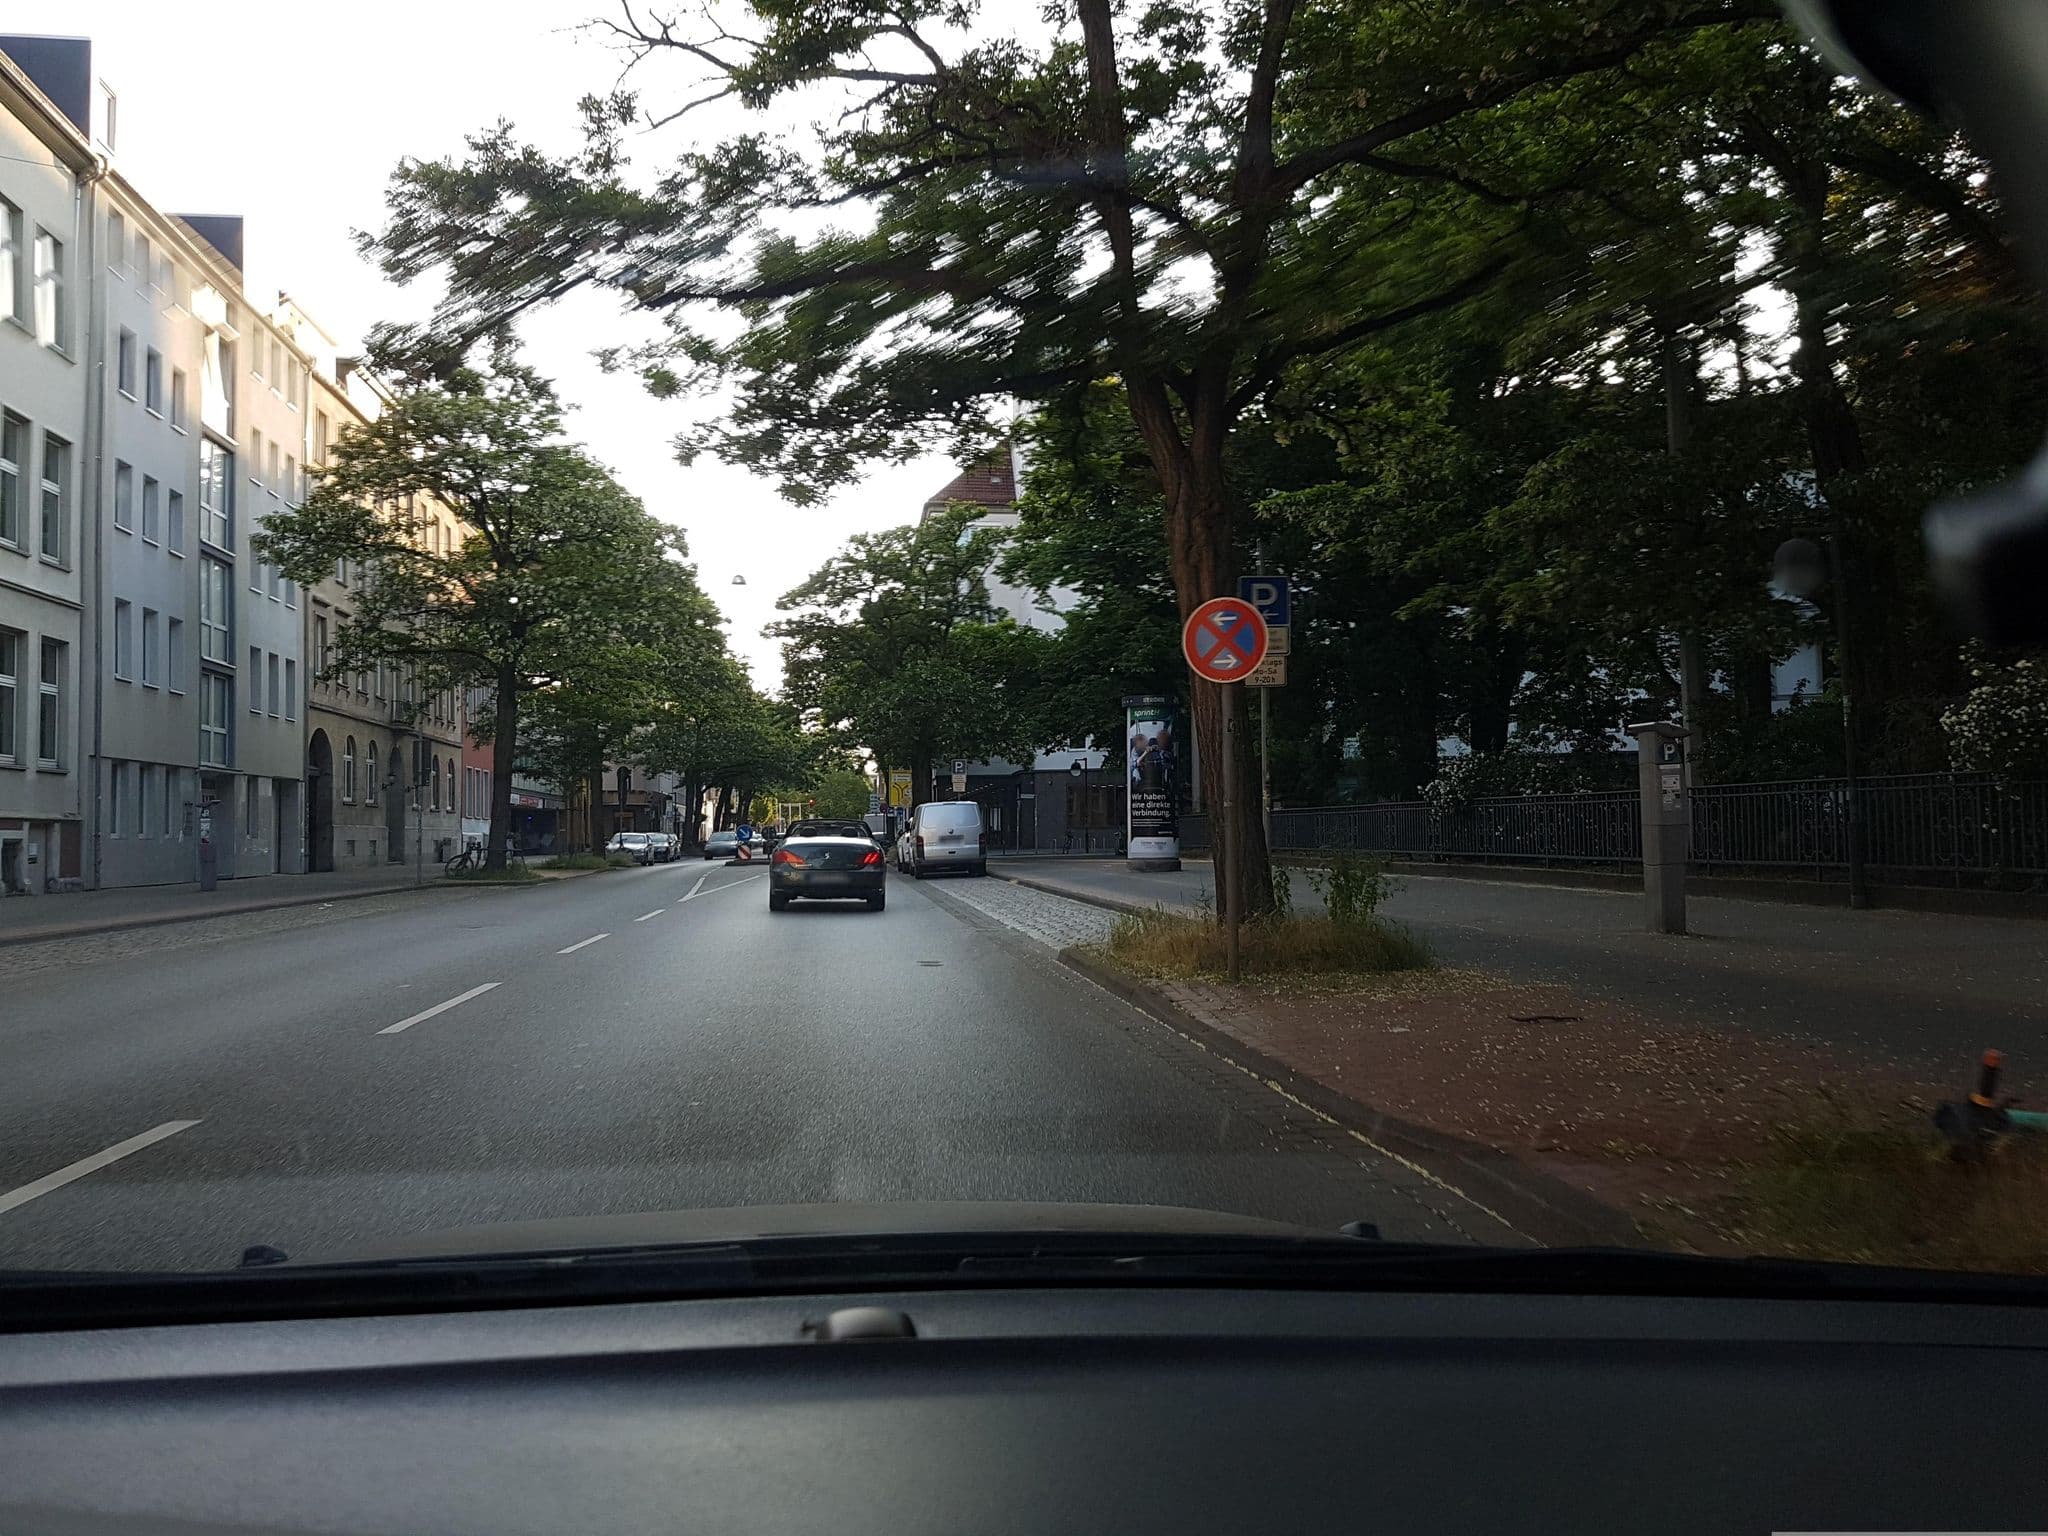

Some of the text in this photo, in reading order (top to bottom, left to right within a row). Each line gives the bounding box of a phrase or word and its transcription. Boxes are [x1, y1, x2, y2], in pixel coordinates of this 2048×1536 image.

[1663, 743, 1676, 761] P
[955, 761, 963, 773] P
[1131, 792, 1166, 800] Wir haben
[1146, 800, 1171, 808] direkte
